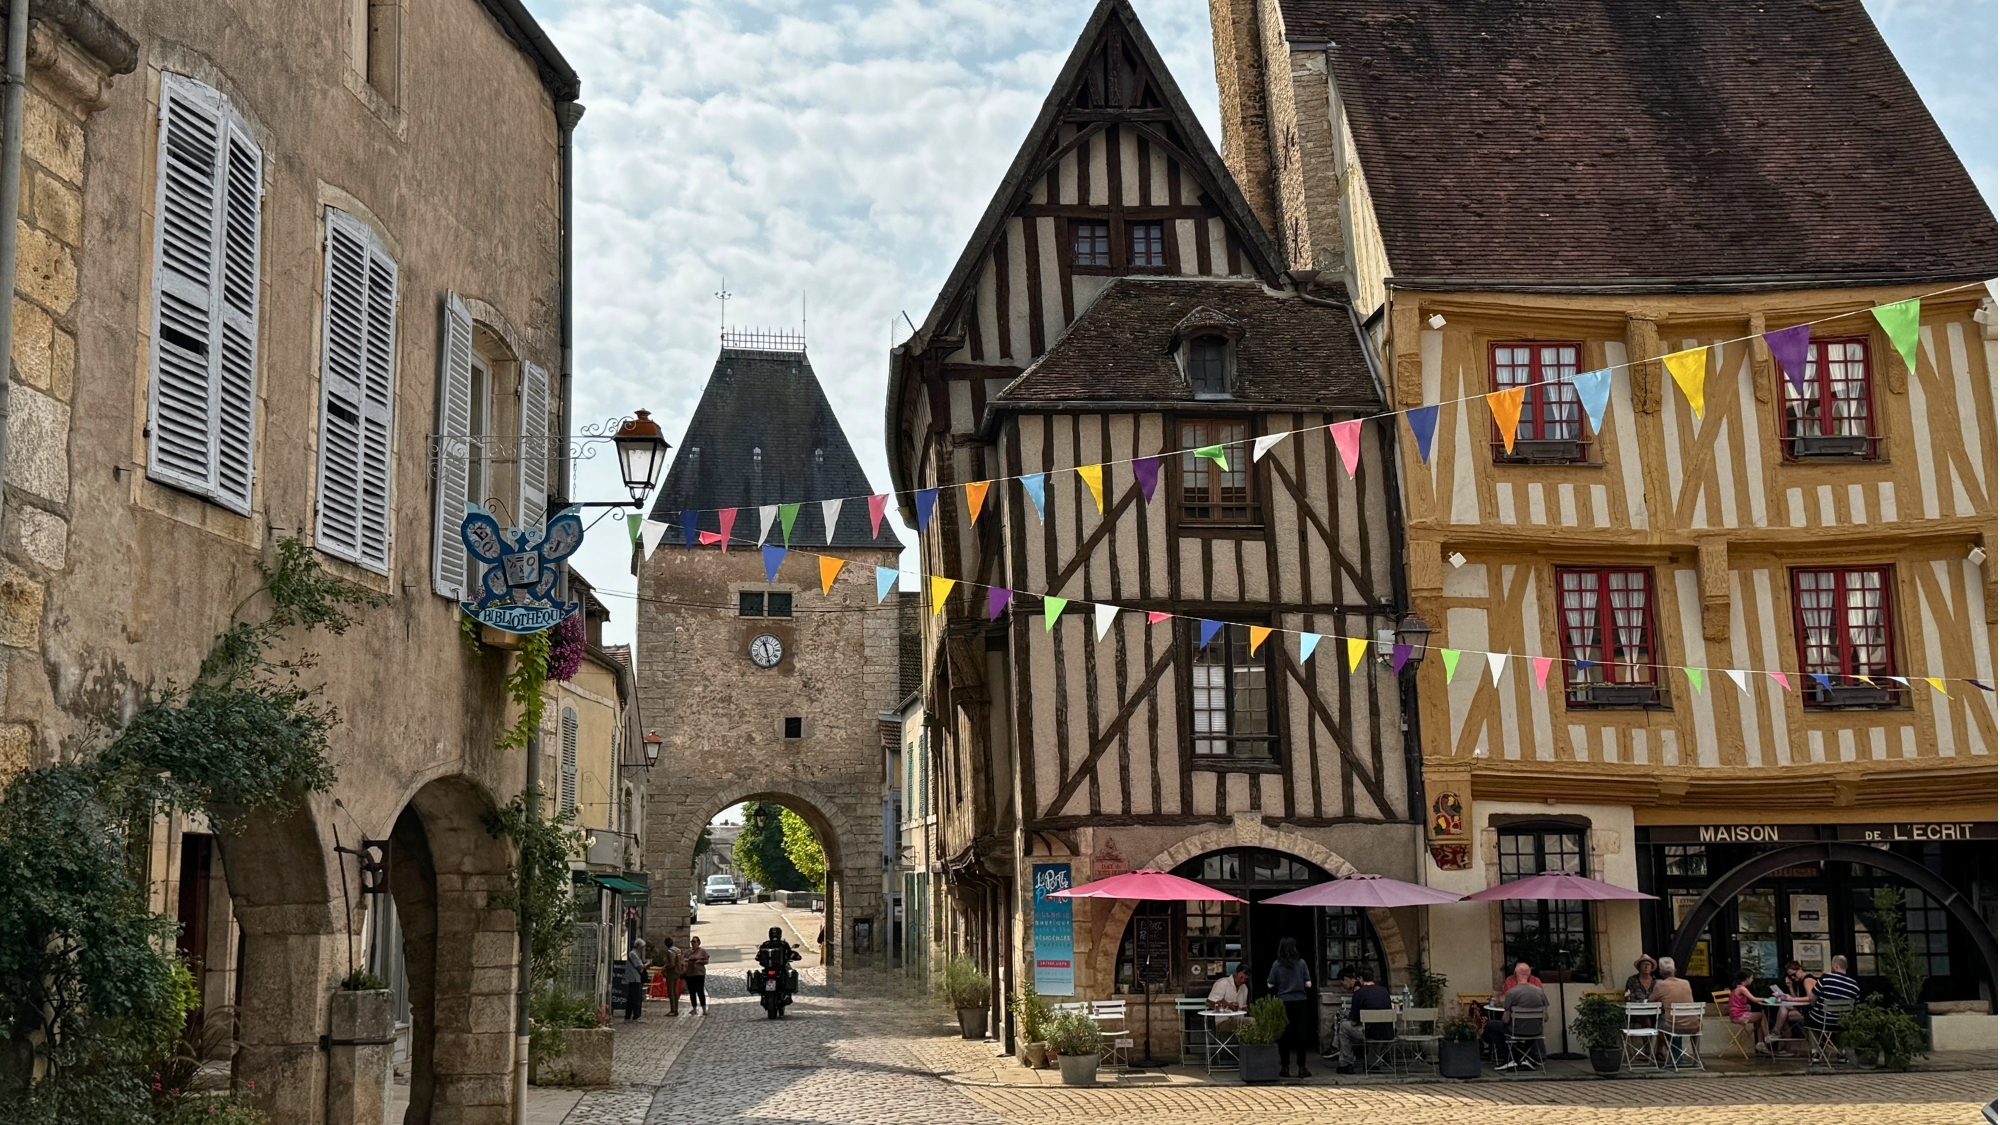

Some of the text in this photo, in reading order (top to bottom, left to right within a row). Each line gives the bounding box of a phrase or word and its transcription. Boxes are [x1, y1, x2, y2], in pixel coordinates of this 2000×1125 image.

[483, 609, 566, 627] BIBLIOTHEQUE
[1699, 823, 1974, 842] MAISON DE L'ECRIT
